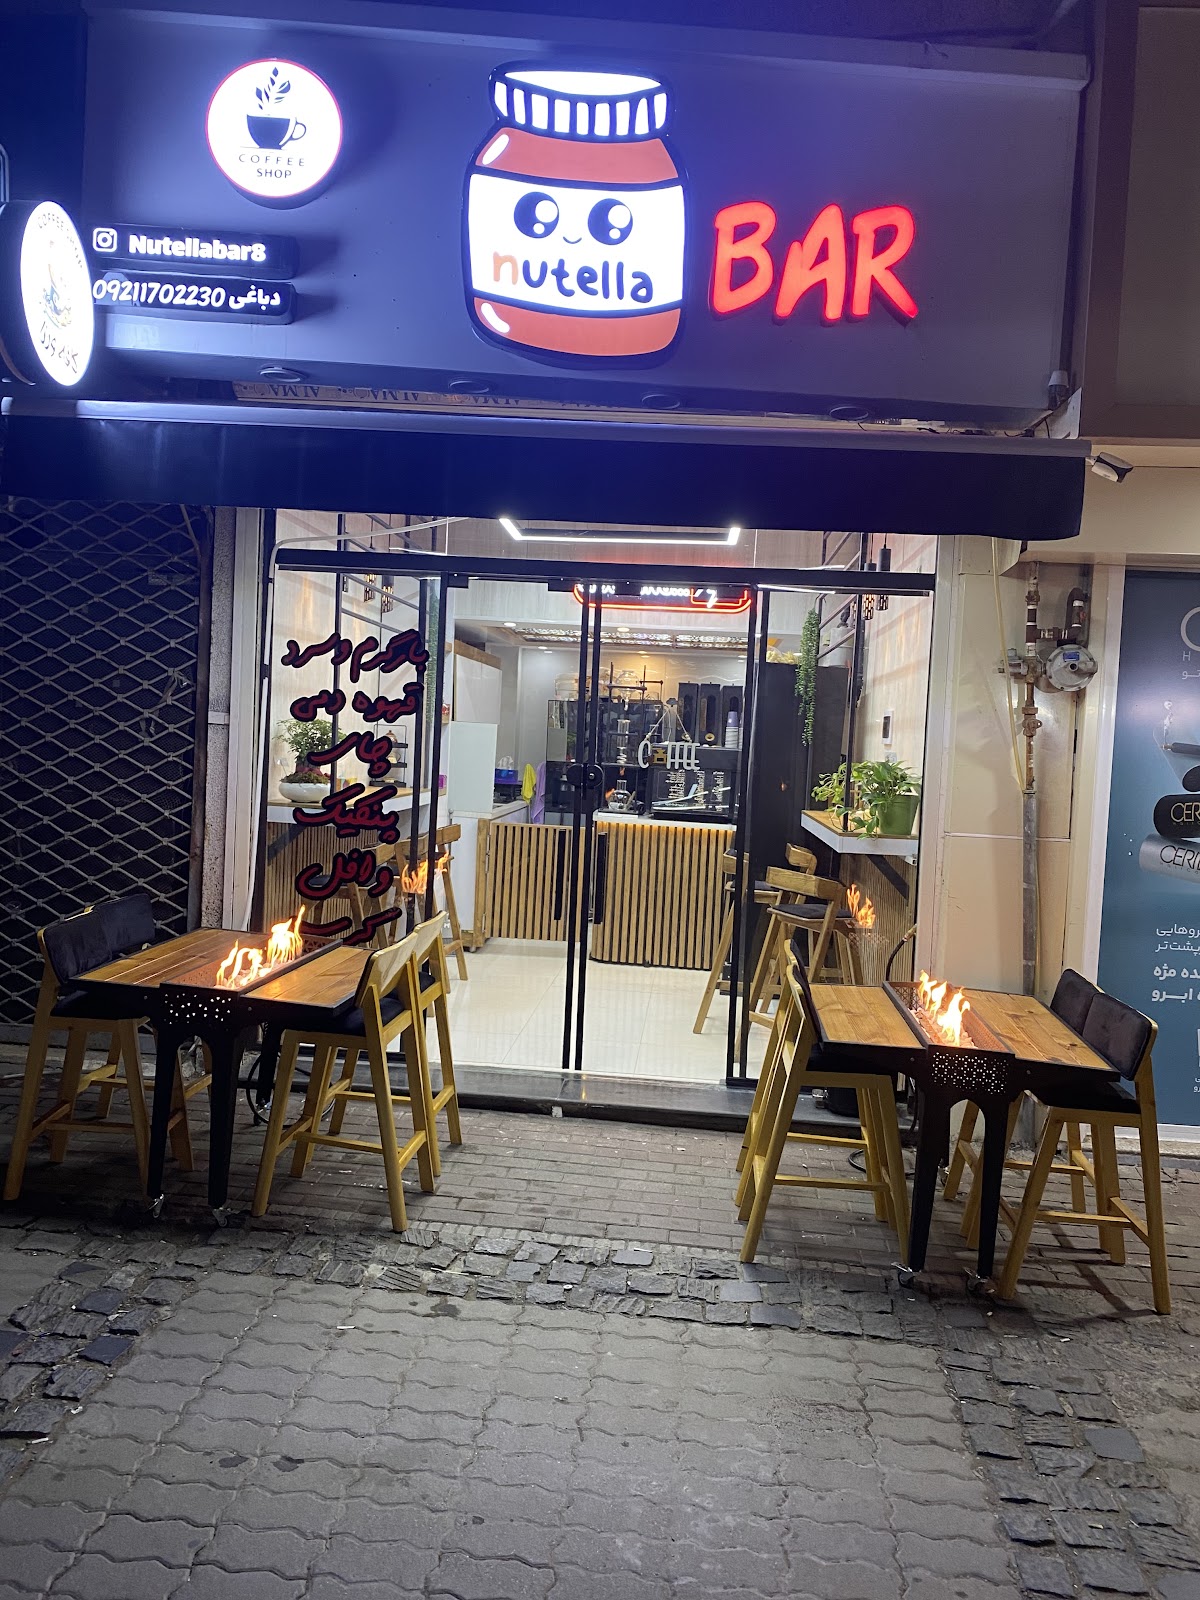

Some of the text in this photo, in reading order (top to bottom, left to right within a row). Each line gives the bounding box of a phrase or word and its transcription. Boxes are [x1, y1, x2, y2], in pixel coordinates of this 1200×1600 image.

[238, 153, 305, 167] COFFEE
[256, 167, 292, 179] SHOP
[128, 234, 267, 262] Nutellabar8
[712, 200, 919, 321] BAR
[492, 251, 655, 304] nutella
[92, 279, 281, 311] 09211702230 دباغی
[1153, 963, 1177, 981] مژه
